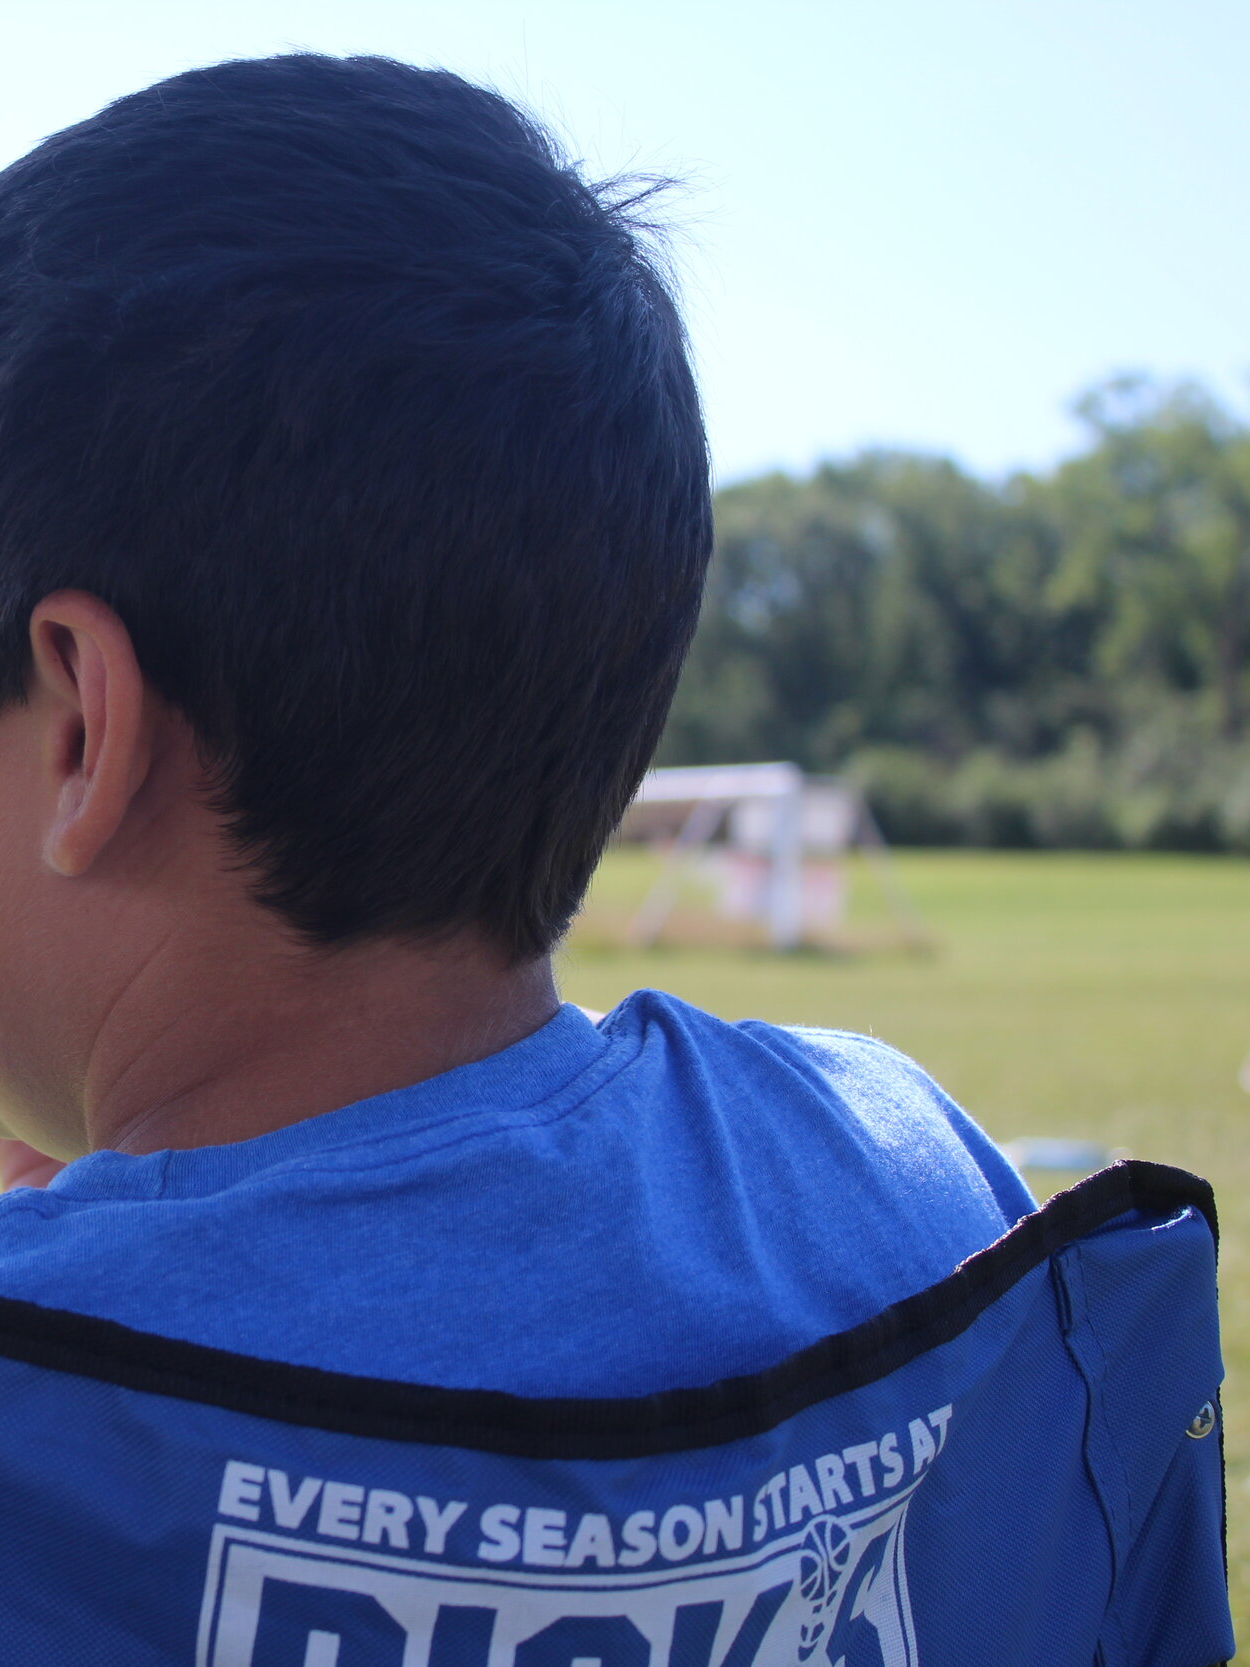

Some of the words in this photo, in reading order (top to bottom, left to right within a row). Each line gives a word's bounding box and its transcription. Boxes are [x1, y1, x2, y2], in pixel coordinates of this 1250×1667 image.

[217, 1460, 468, 1554] EVERY
[477, 1495, 744, 1568] SEASON
[753, 1432, 903, 1541] STARTS
[908, 1403, 952, 1475] AT
